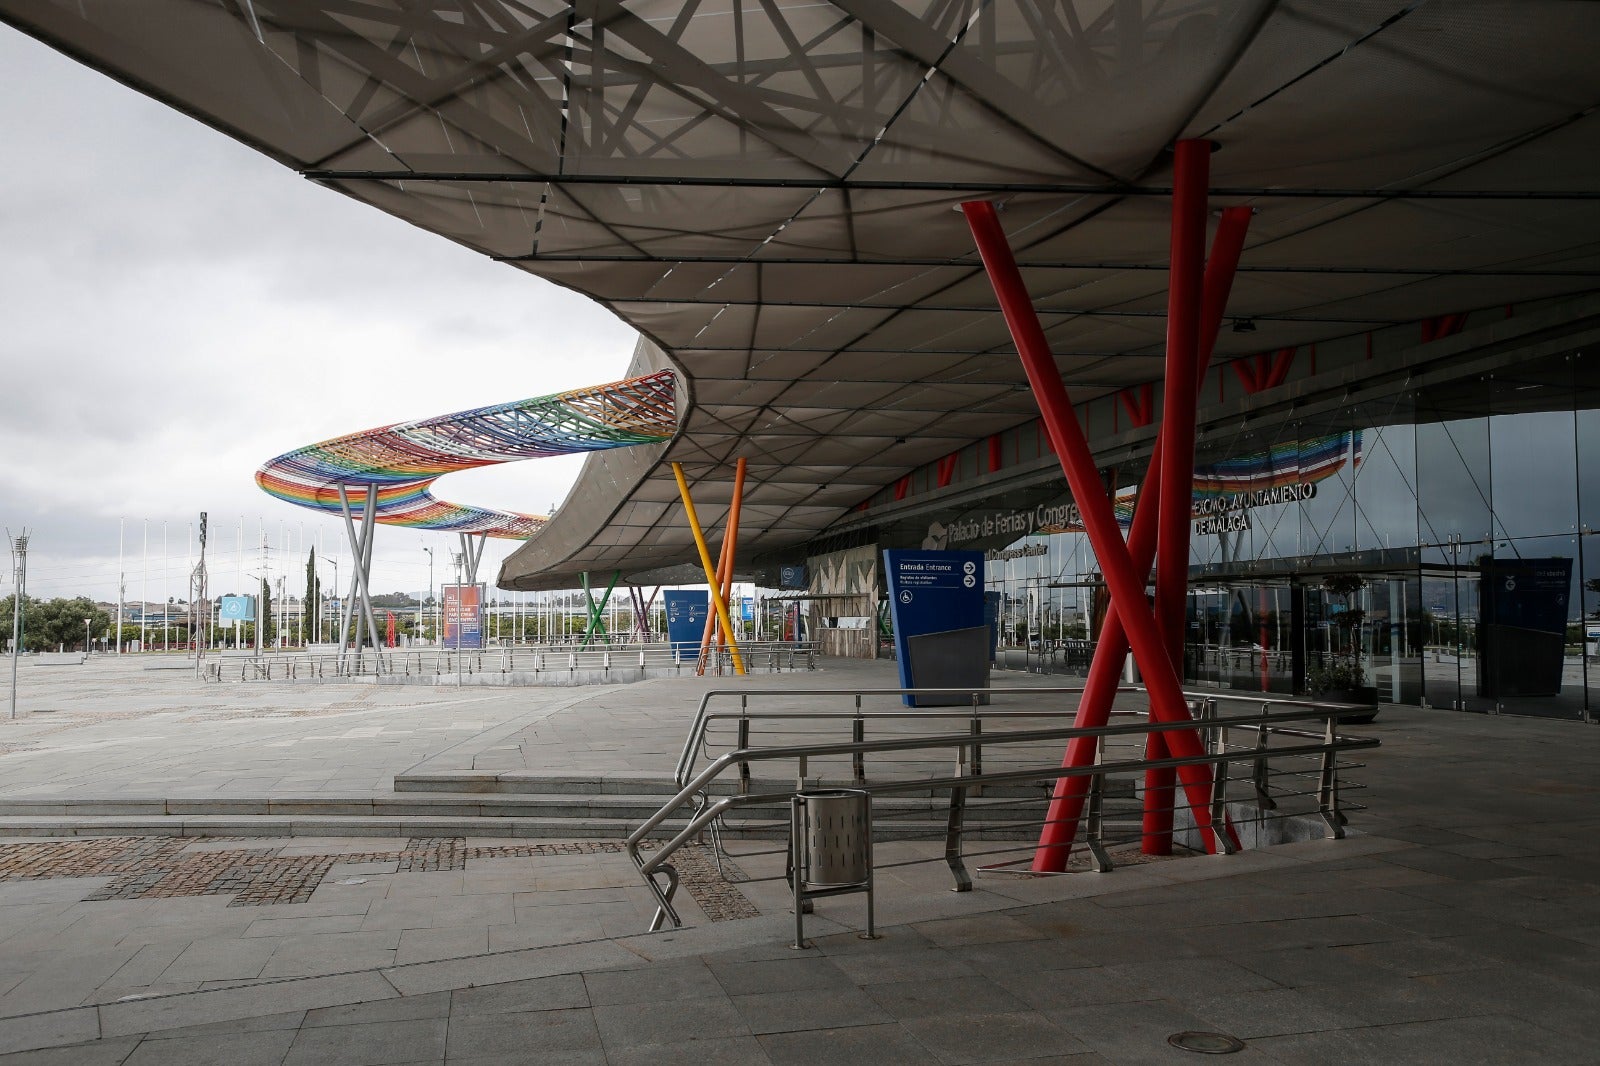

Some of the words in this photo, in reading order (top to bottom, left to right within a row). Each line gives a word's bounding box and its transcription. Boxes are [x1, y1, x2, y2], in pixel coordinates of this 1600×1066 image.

[1194, 496, 1229, 515] EXCMO.
[1231, 481, 1317, 509] AYUNTAMIENTO
[949, 518, 980, 543] Palacio
[981, 515, 994, 537] de
[995, 509, 1026, 535] Ferias
[1027, 511, 1035, 536] y
[1037, 503, 1079, 529] Congre
[1195, 520, 1207, 536] DE
[992, 548, 1022, 562] Congress
[1023, 543, 1048, 557] Center
[899, 563, 924, 571] Entrada
